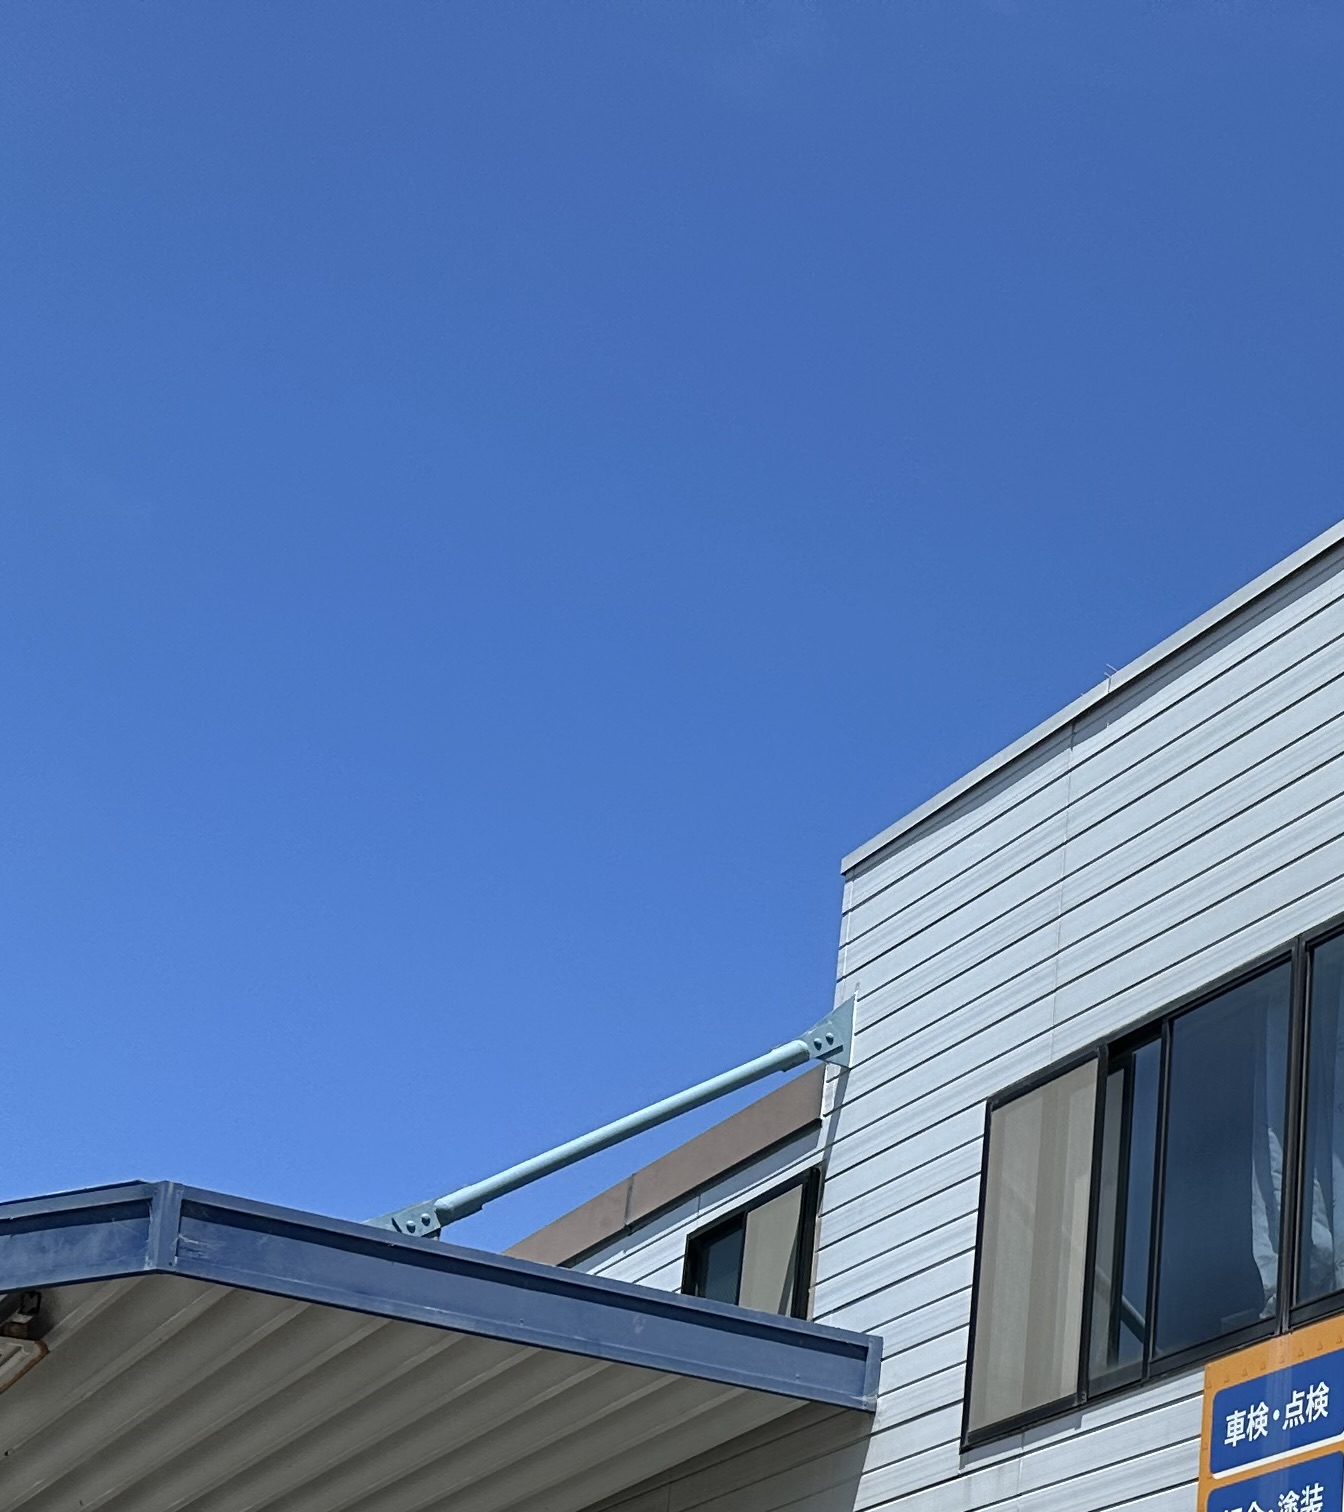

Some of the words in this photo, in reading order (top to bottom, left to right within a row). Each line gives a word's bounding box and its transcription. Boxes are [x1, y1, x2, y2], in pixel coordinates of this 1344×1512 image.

[1224, 1384, 1331, 1446] 車検・点検
